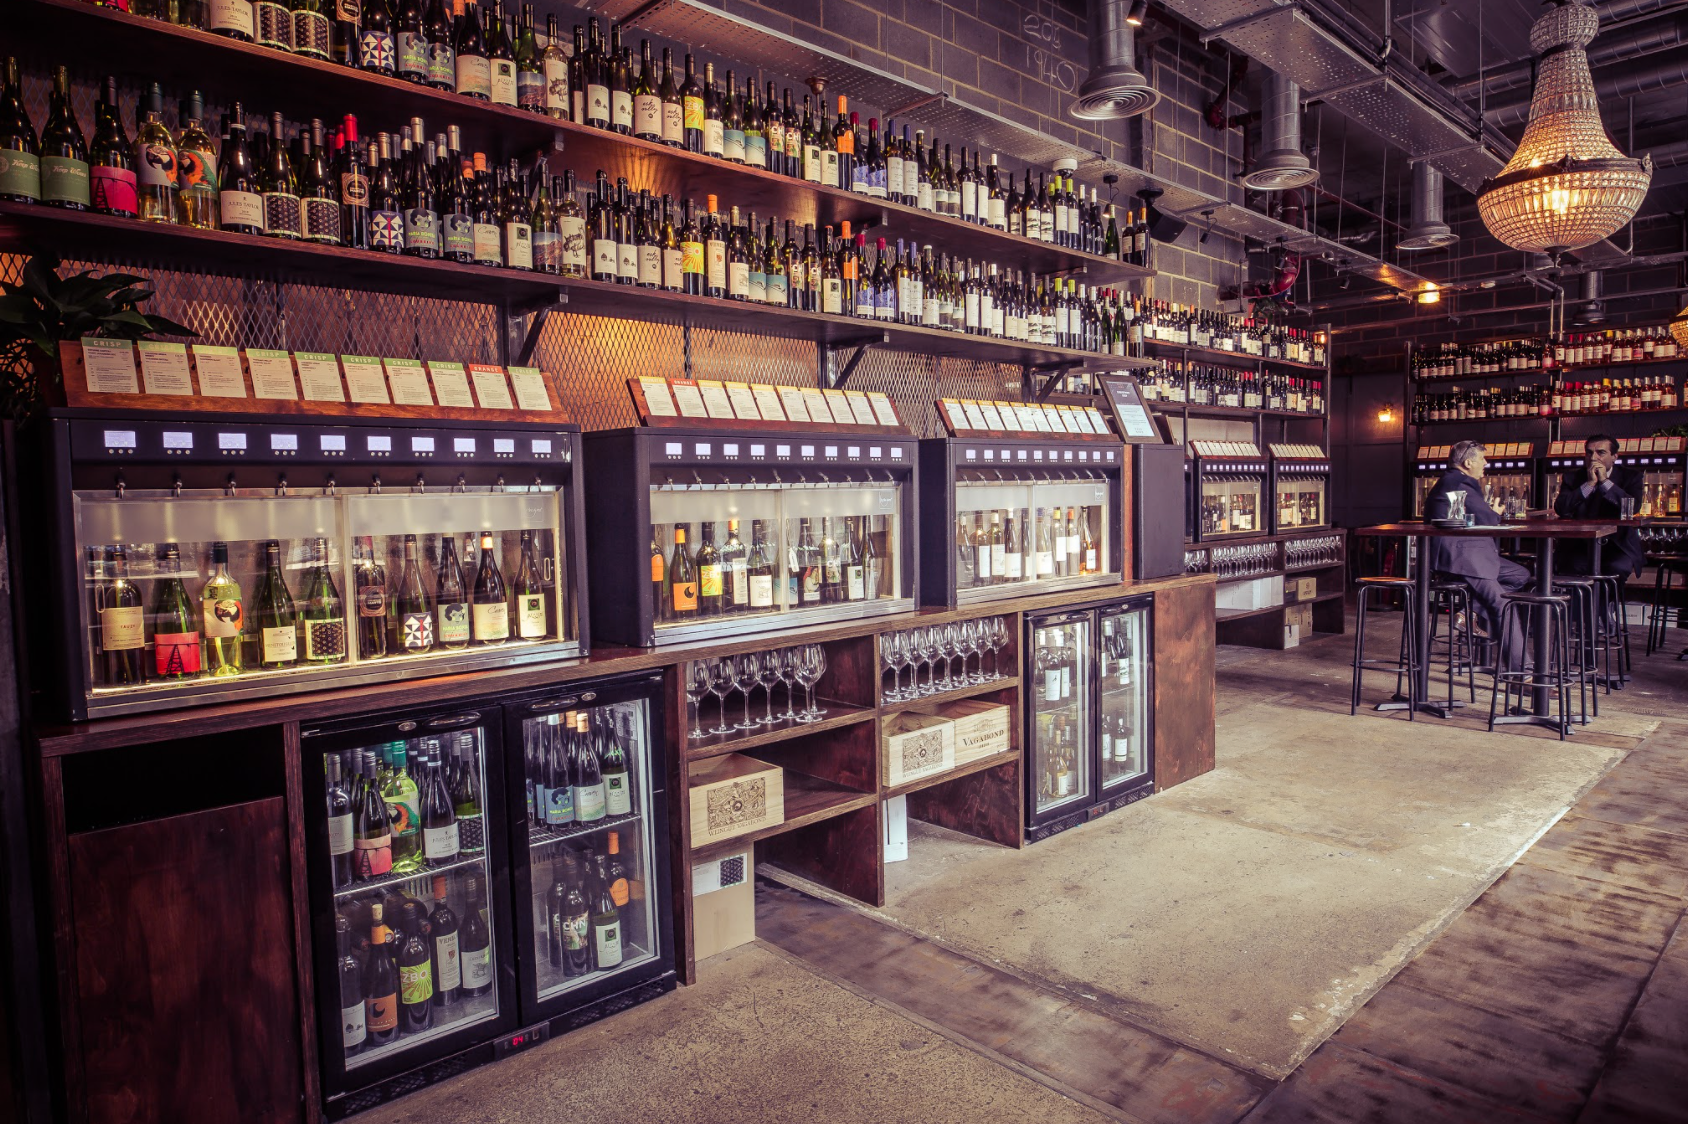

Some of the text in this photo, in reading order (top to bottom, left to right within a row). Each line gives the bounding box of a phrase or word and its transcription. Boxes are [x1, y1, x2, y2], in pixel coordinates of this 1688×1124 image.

[1026, 45, 1076, 94] 1940
[93, 340, 122, 348] CRISP
[962, 729, 1004, 747] VAGABOND
[402, 969, 428, 983] ZBO
[512, 1035, 524, 1046] 04
